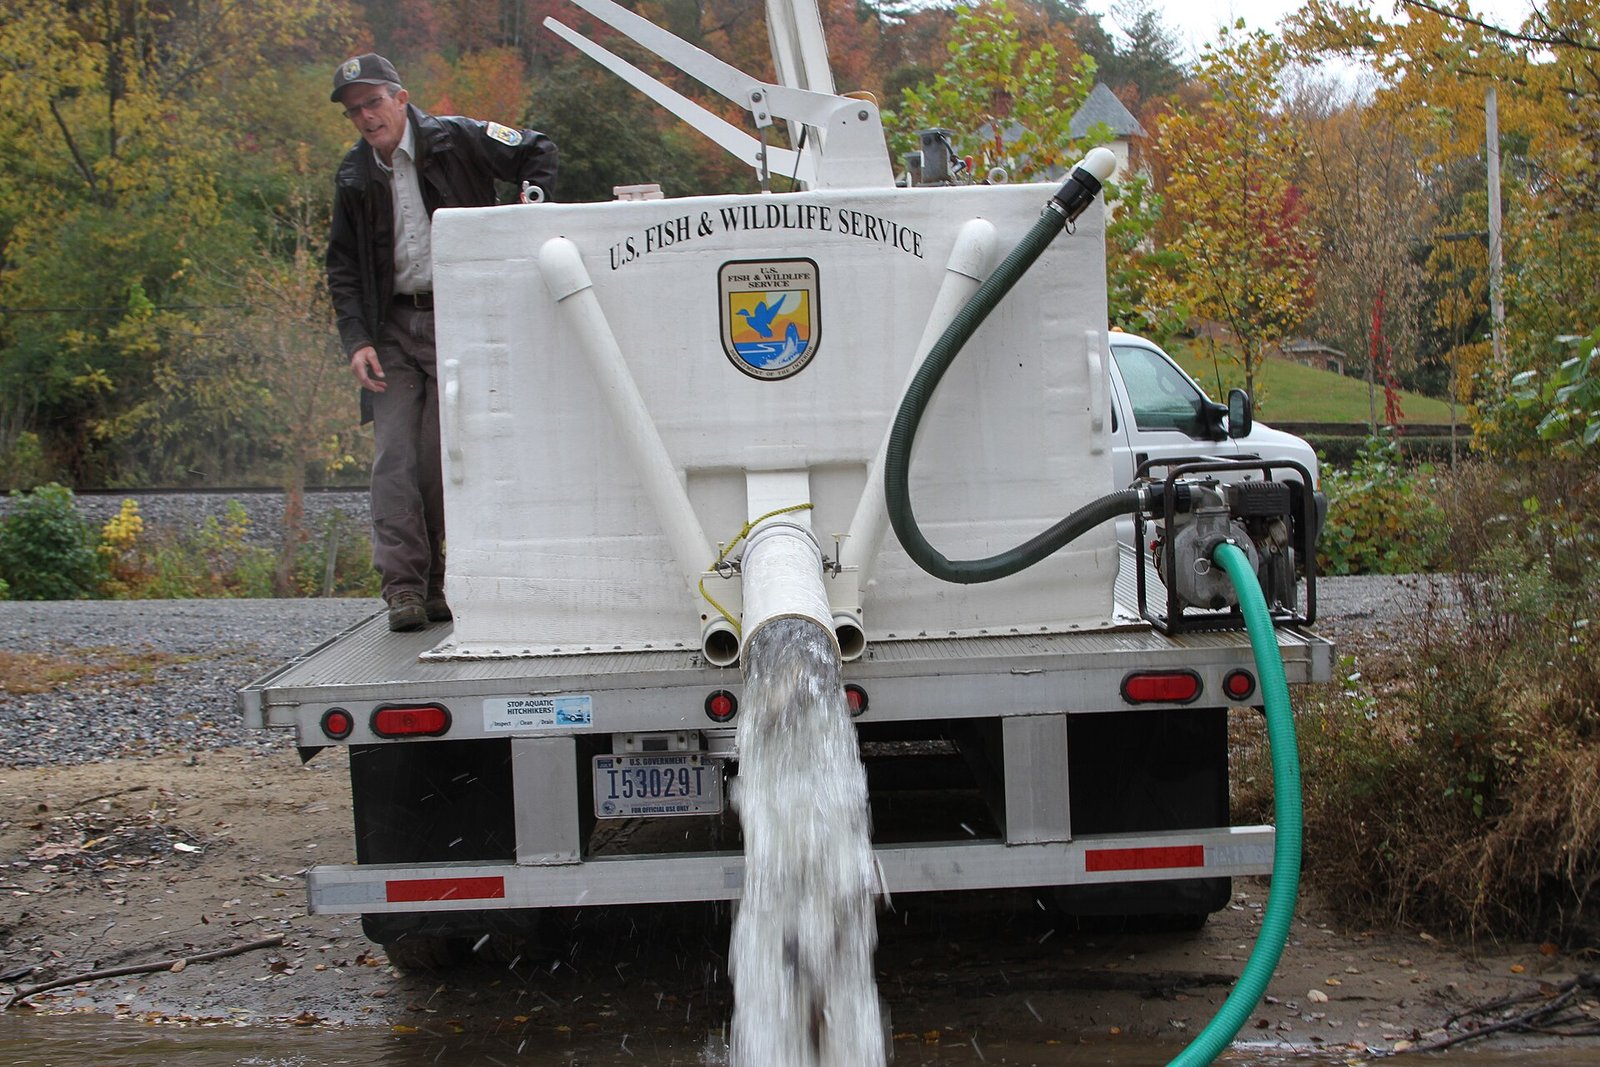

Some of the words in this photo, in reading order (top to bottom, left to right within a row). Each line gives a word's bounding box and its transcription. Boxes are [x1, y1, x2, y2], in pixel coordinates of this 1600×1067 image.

[609, 236, 640, 270] U.S.
[645, 215, 691, 254] FISH
[698, 211, 713, 237] &
[720, 203, 832, 232] WILDLIFE
[838, 208, 924, 259] SERVICE
[748, 280, 789, 288] SERVICE
[507, 707, 555, 715] HITCHHIKERS!
[629, 758, 642, 766] U.S.
[643, 757, 687, 766] GOVERNMENT
[607, 766, 705, 799] I53029T
